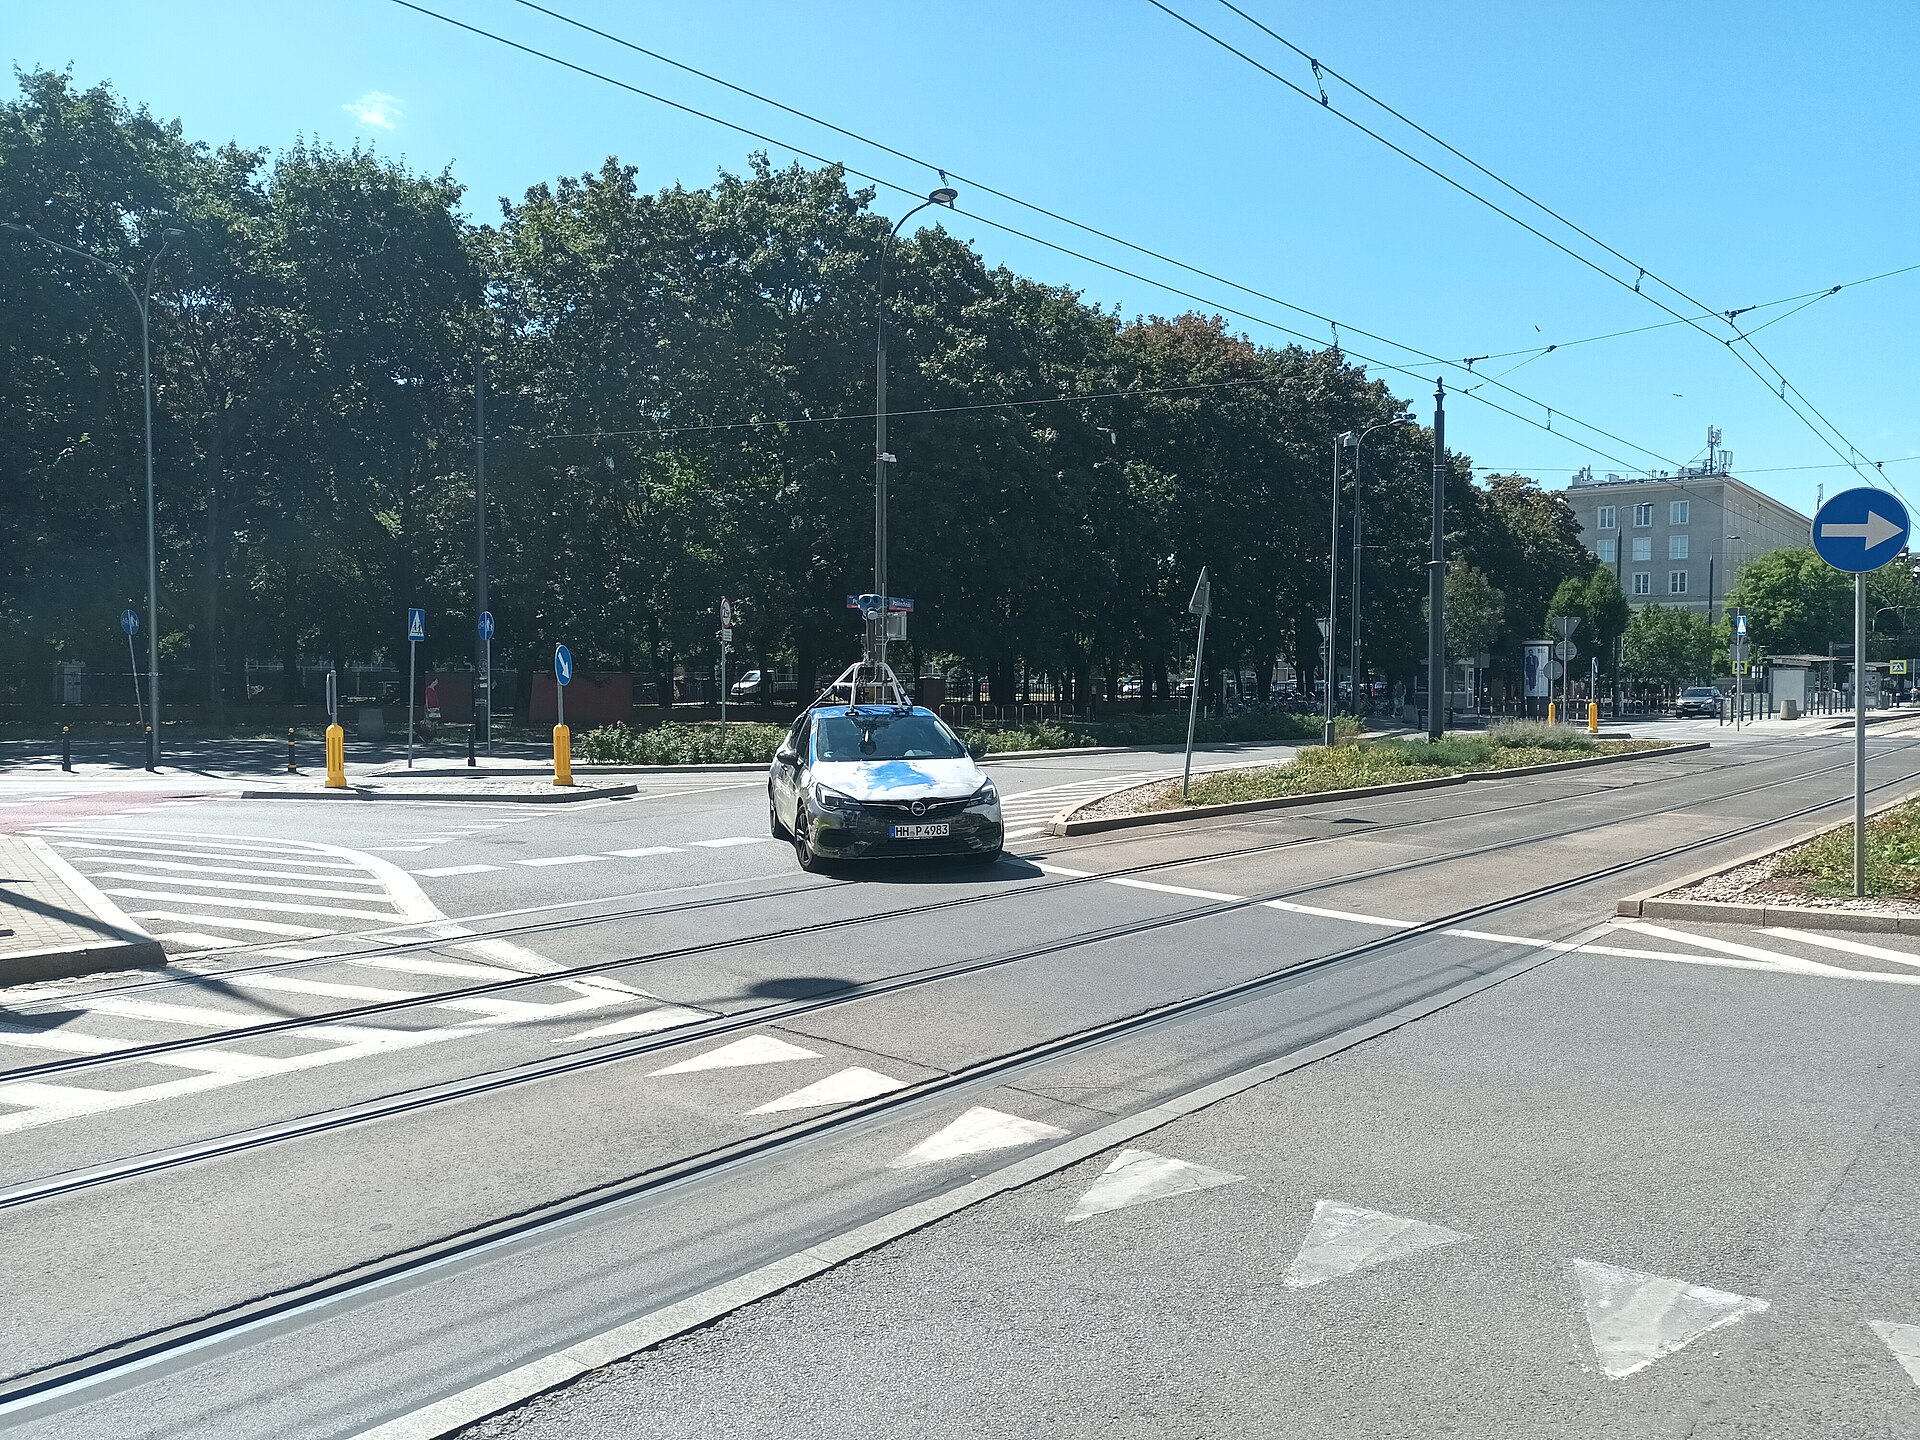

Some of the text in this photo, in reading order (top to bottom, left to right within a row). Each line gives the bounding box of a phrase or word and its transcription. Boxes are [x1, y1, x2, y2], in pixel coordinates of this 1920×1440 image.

[896, 825, 948, 836] HH P 4983
